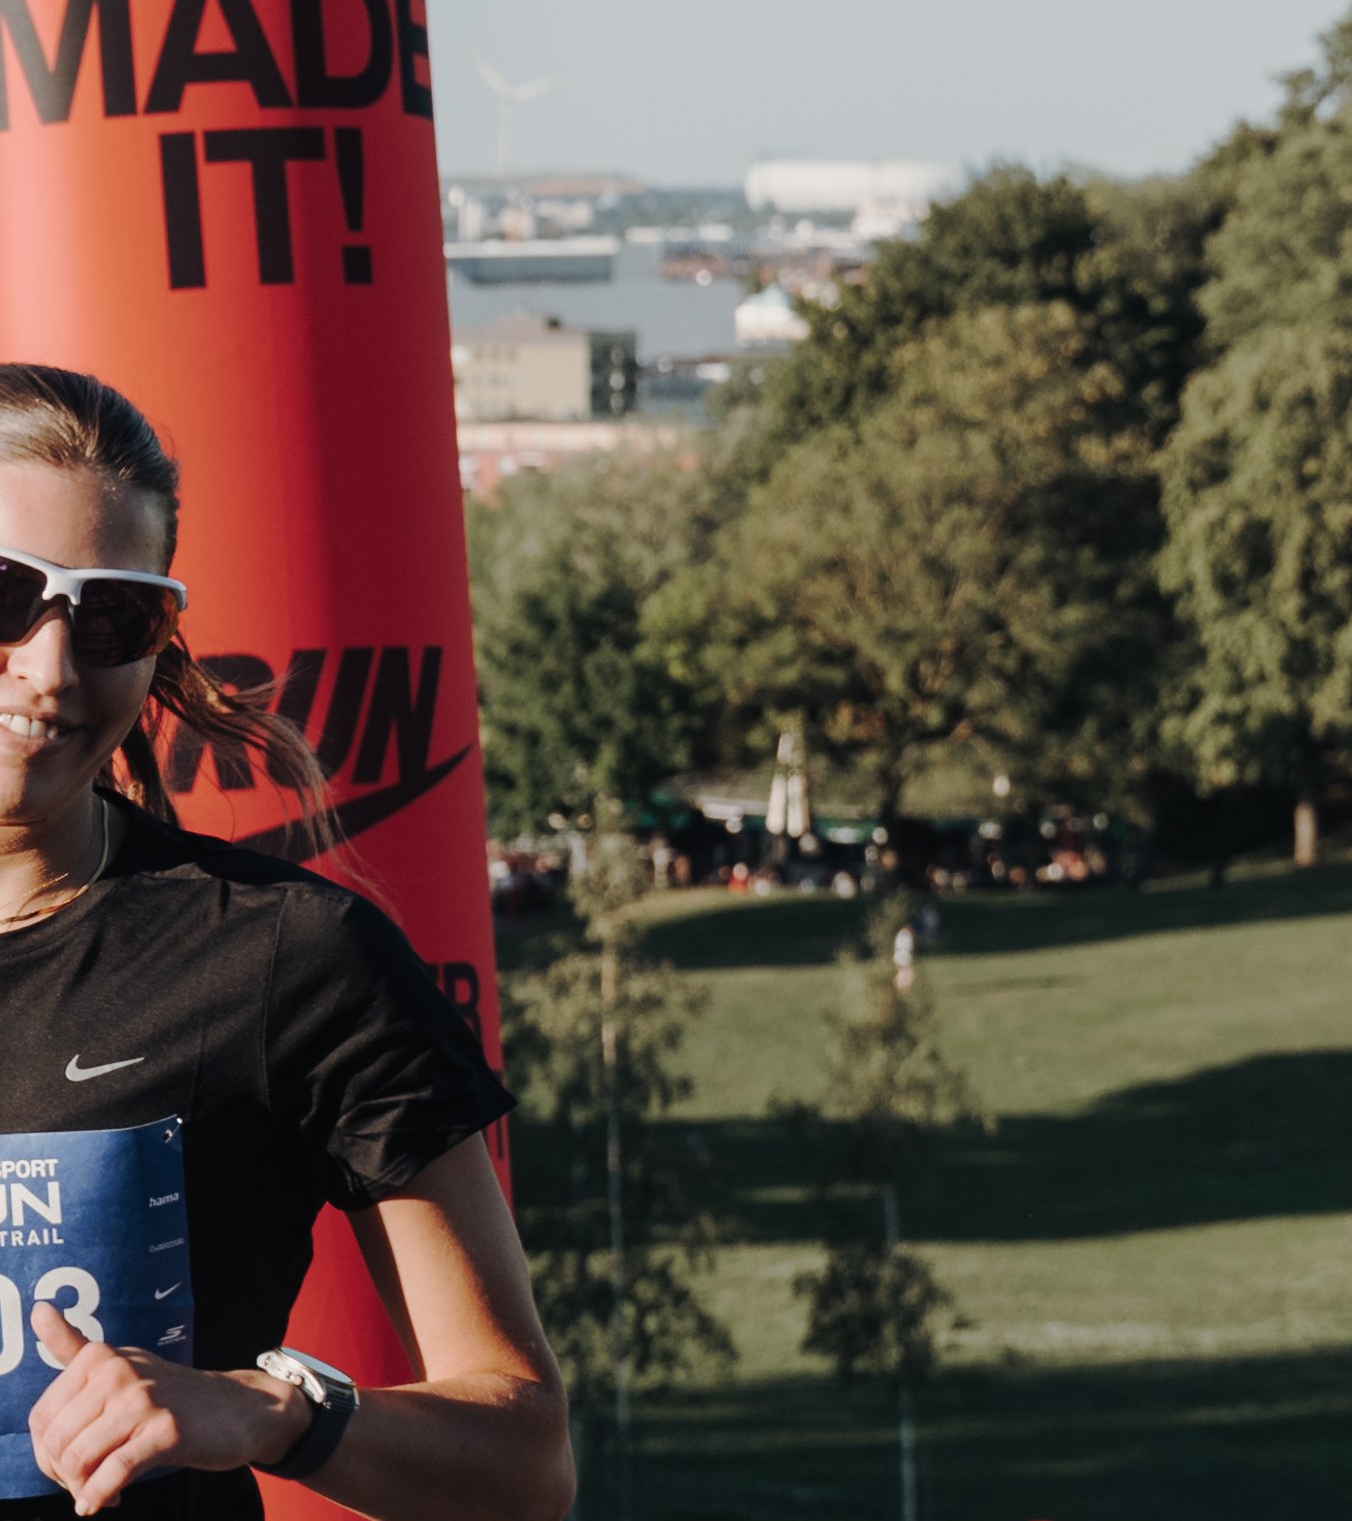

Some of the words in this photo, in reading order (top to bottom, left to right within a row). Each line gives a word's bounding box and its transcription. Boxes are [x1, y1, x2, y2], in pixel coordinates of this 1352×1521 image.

[157, 125, 375, 291] IT!
[169, 645, 443, 793] RUN
[149, 1192, 180, 1207] hama
